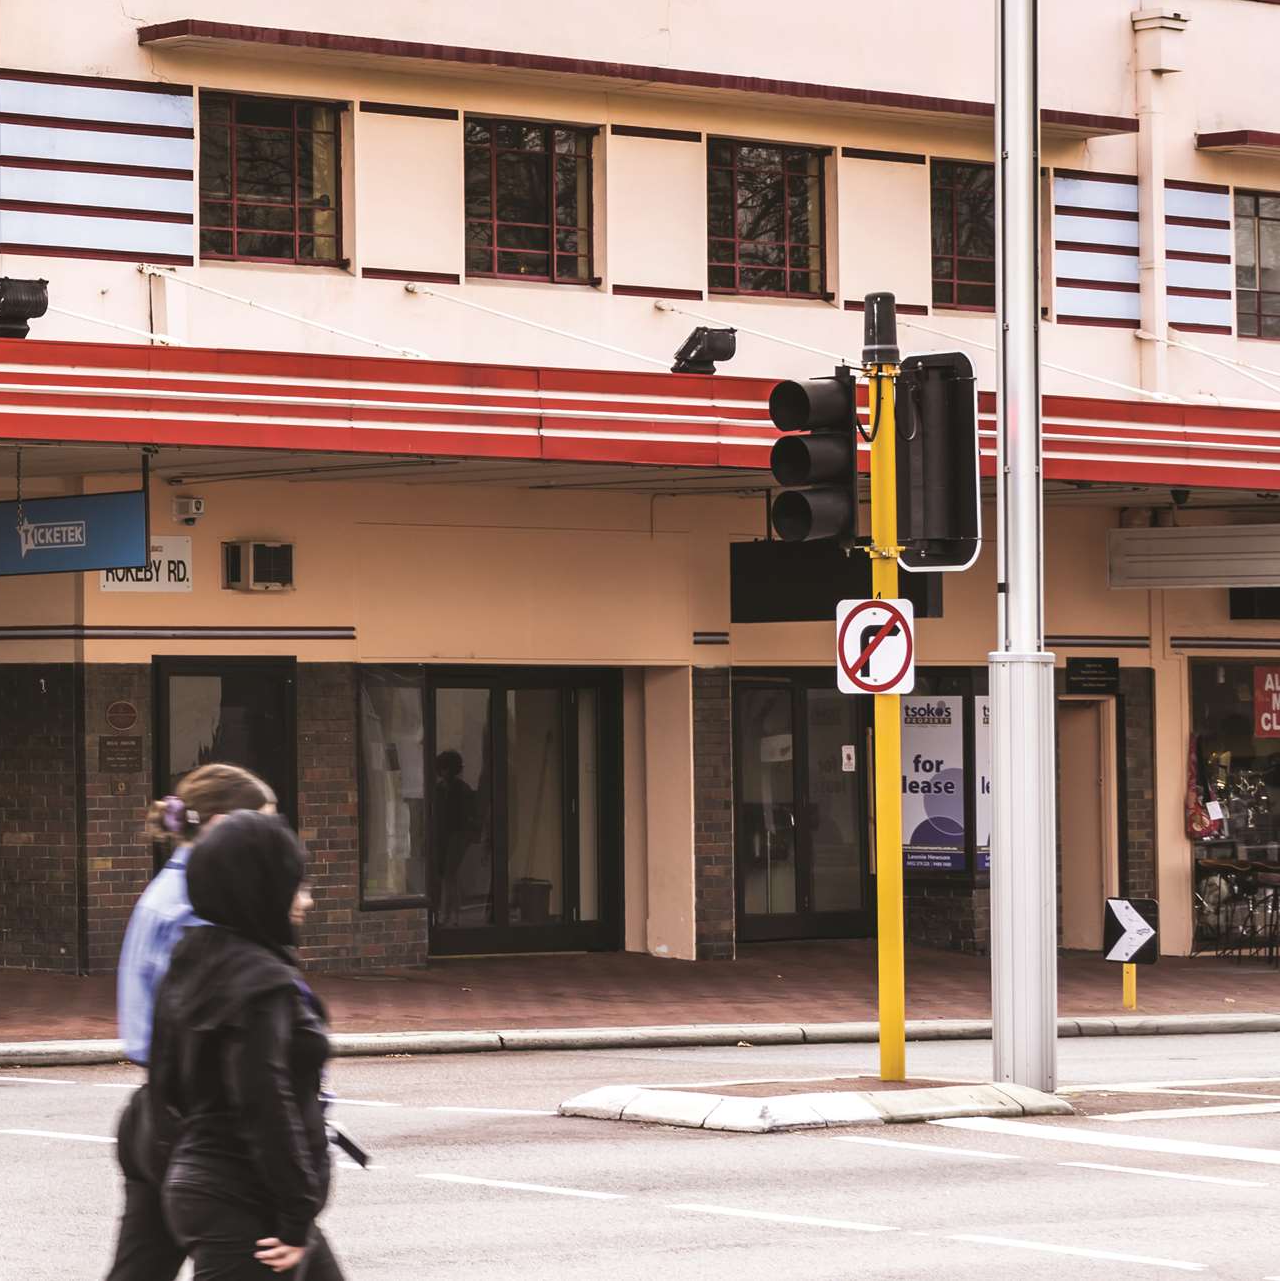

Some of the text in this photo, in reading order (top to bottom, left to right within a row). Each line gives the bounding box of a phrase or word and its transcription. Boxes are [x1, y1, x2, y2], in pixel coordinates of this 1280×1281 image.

[22, 525, 83, 545] TICKETEK
[167, 560, 190, 583] RD.
[913, 754, 944, 773] for
[902, 775, 955, 795] lease
